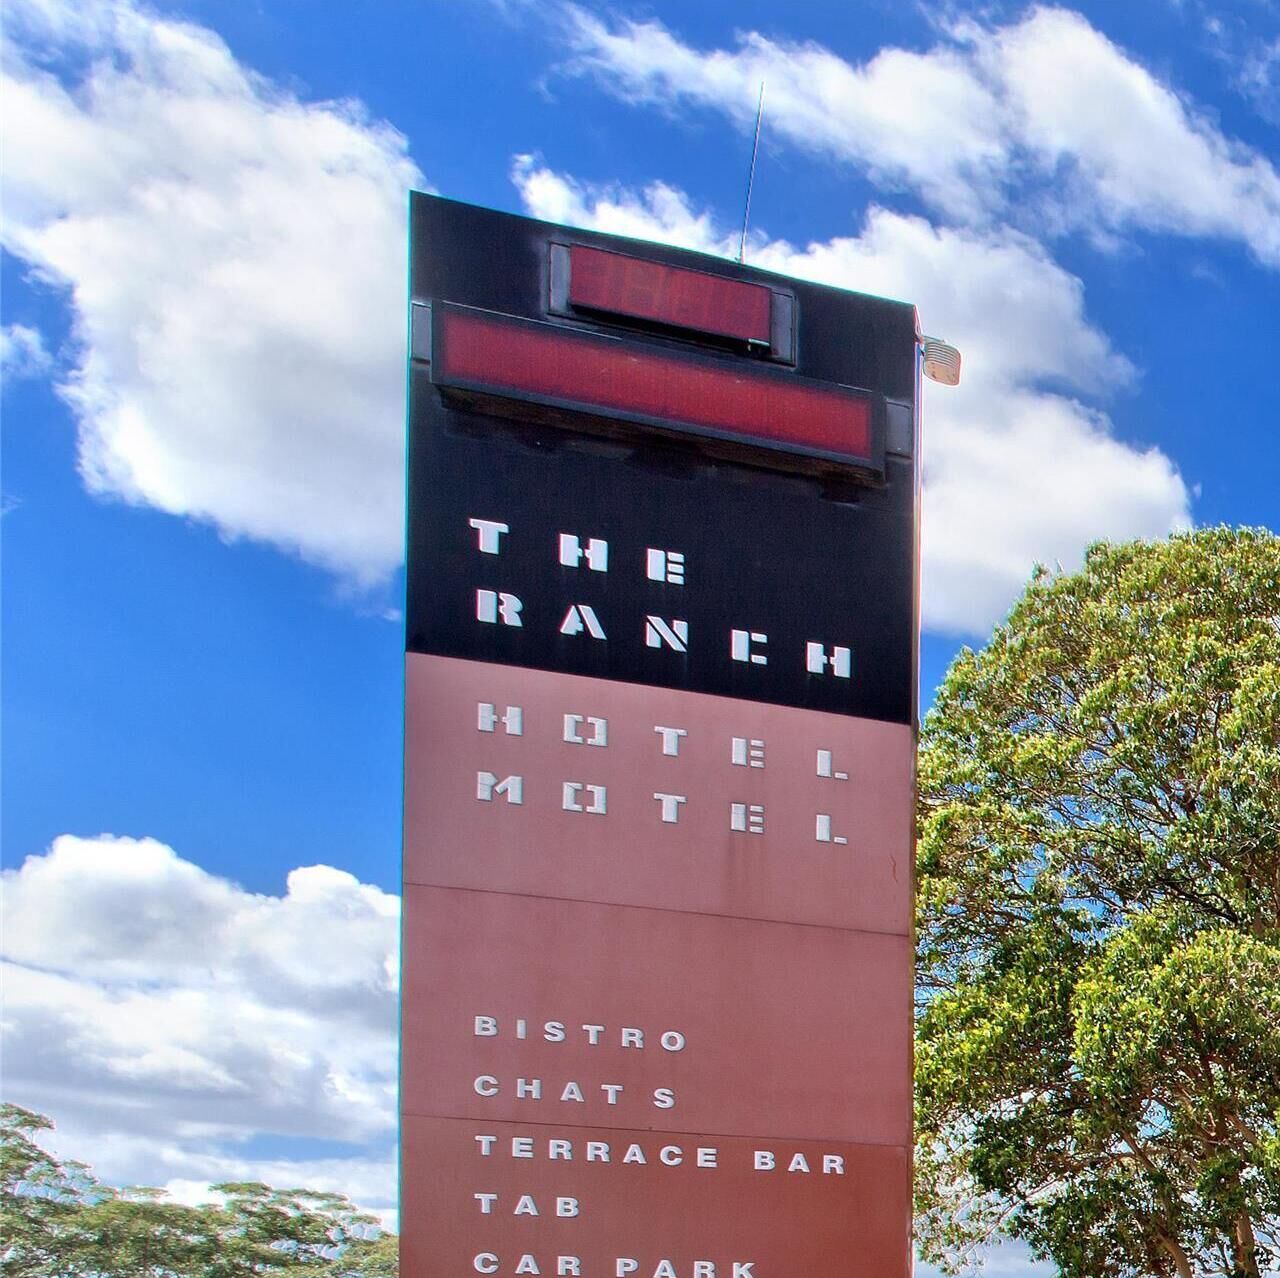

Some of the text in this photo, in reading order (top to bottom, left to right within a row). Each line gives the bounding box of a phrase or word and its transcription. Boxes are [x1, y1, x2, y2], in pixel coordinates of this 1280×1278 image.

[469, 518, 684, 585] THE
[477, 589, 851, 678] RANCH
[477, 702, 848, 780] HOTEL
[476, 771, 848, 844] MOTEL
[474, 1015, 685, 1051] BISTRO
[474, 1135, 844, 1175] TERRACE BAR
[474, 1193, 579, 1217] TAB
[473, 1252, 580, 1276] CAR
